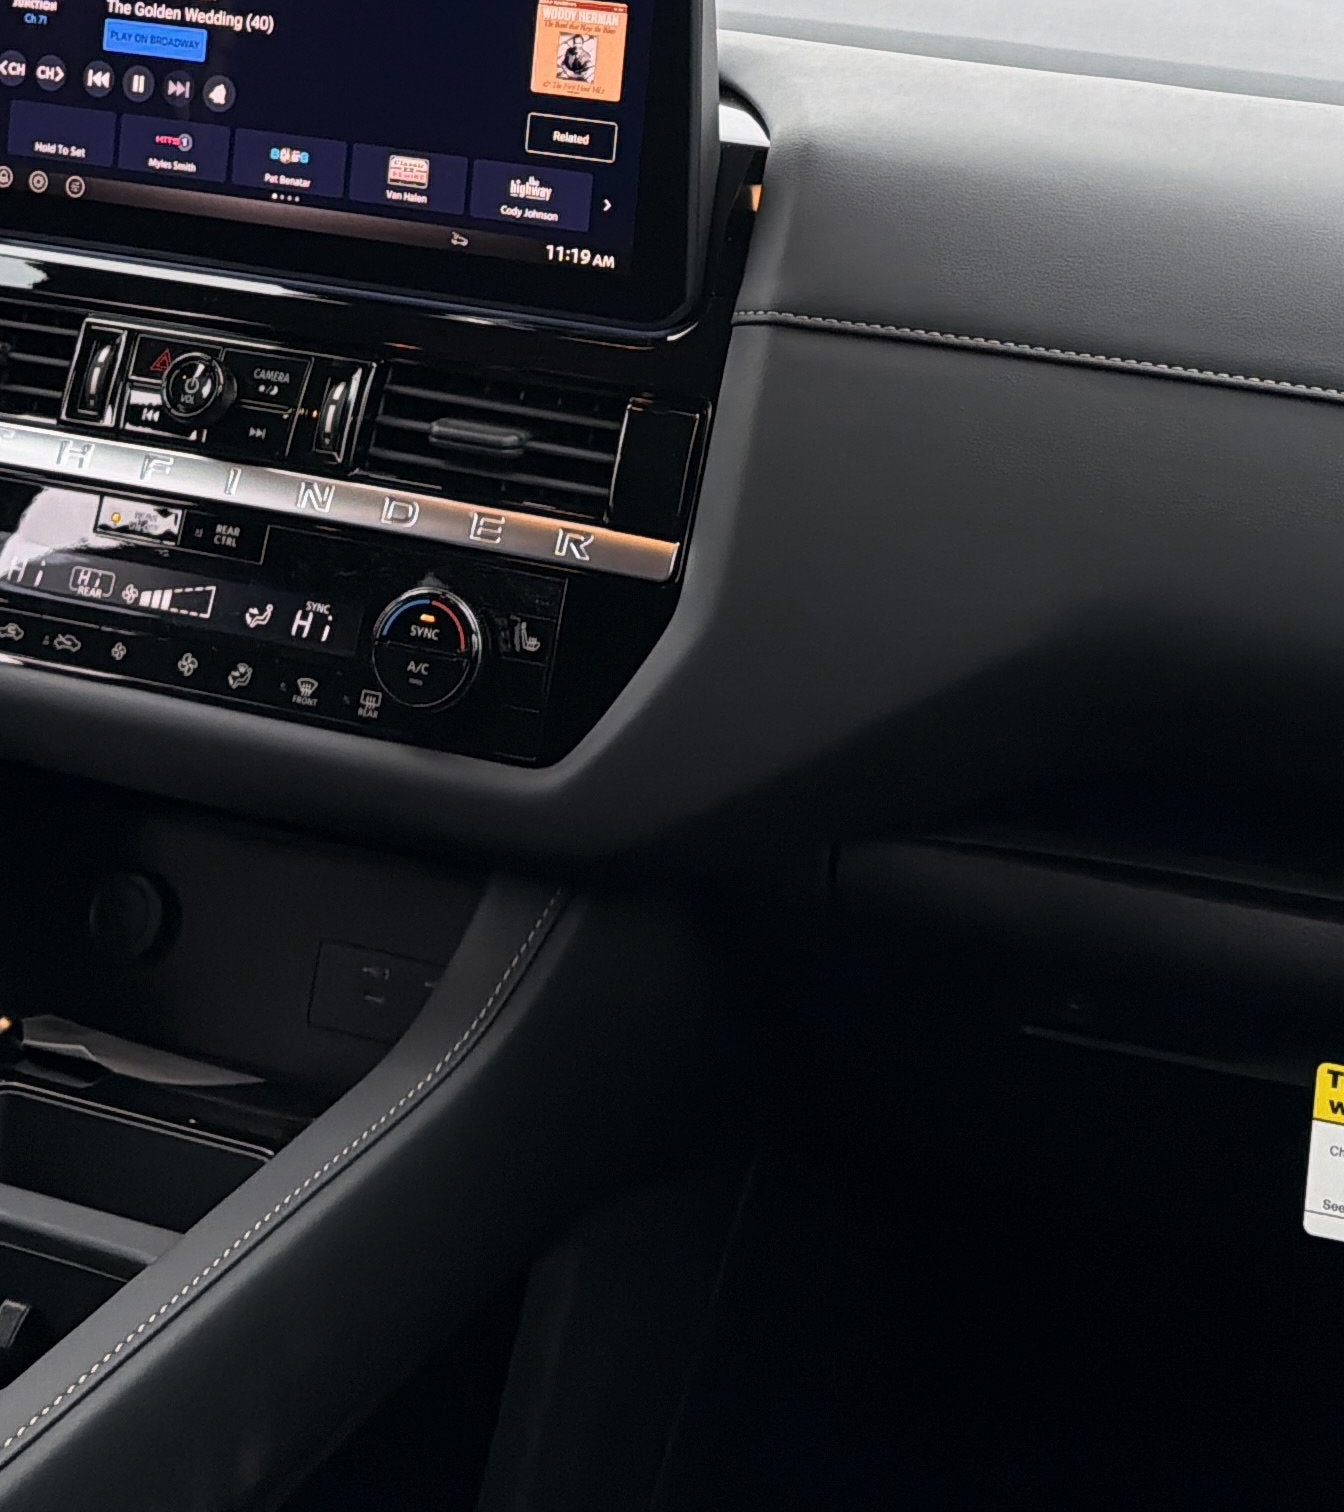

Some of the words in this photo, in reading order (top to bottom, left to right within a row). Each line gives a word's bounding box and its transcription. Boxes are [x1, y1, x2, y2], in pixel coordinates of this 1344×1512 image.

[24, 13, 36, 24] Ch
[134, 2, 182, 21] Golden
[185, 7, 243, 32] Wedding
[246, 12, 274, 35] (40)
[542, 6, 578, 22] WOODY
[579, 11, 620, 26] HERMAN
[110, 30, 132, 42] PLAY
[135, 33, 149, 44] ON
[150, 34, 201, 50] BROADWAY
[552, 130, 590, 146] Related
[33, 141, 55, 155] Hold
[56, 144, 69, 155] To
[70, 146, 86, 159] Set
[148, 158, 172, 170] Myles
[173, 160, 196, 173] Smith
[264, 173, 278, 183] Pat
[280, 175, 311, 188] Benatar
[528, 175, 540, 187] the
[386, 189, 402, 203] Van
[403, 192, 428, 204] Halen
[510, 179, 552, 201] highway
[500, 205, 522, 219] Cody
[524, 207, 558, 222] Johnson
[545, 244, 591, 265] 11:19
[592, 254, 615, 269] AM
[253, 367, 290, 384] CAMERA
[180, 394, 194, 404] VOL
[216, 524, 240, 536] REAR
[214, 535, 236, 548] CTRL
[77, 585, 103, 599] REAR
[305, 600, 331, 615] SYNC
[291, 609, 333, 642] Hi
[409, 625, 441, 641] SYNC
[406, 660, 430, 676] A/C
[292, 693, 318, 708] FRONT
[357, 706, 379, 719] REAR
